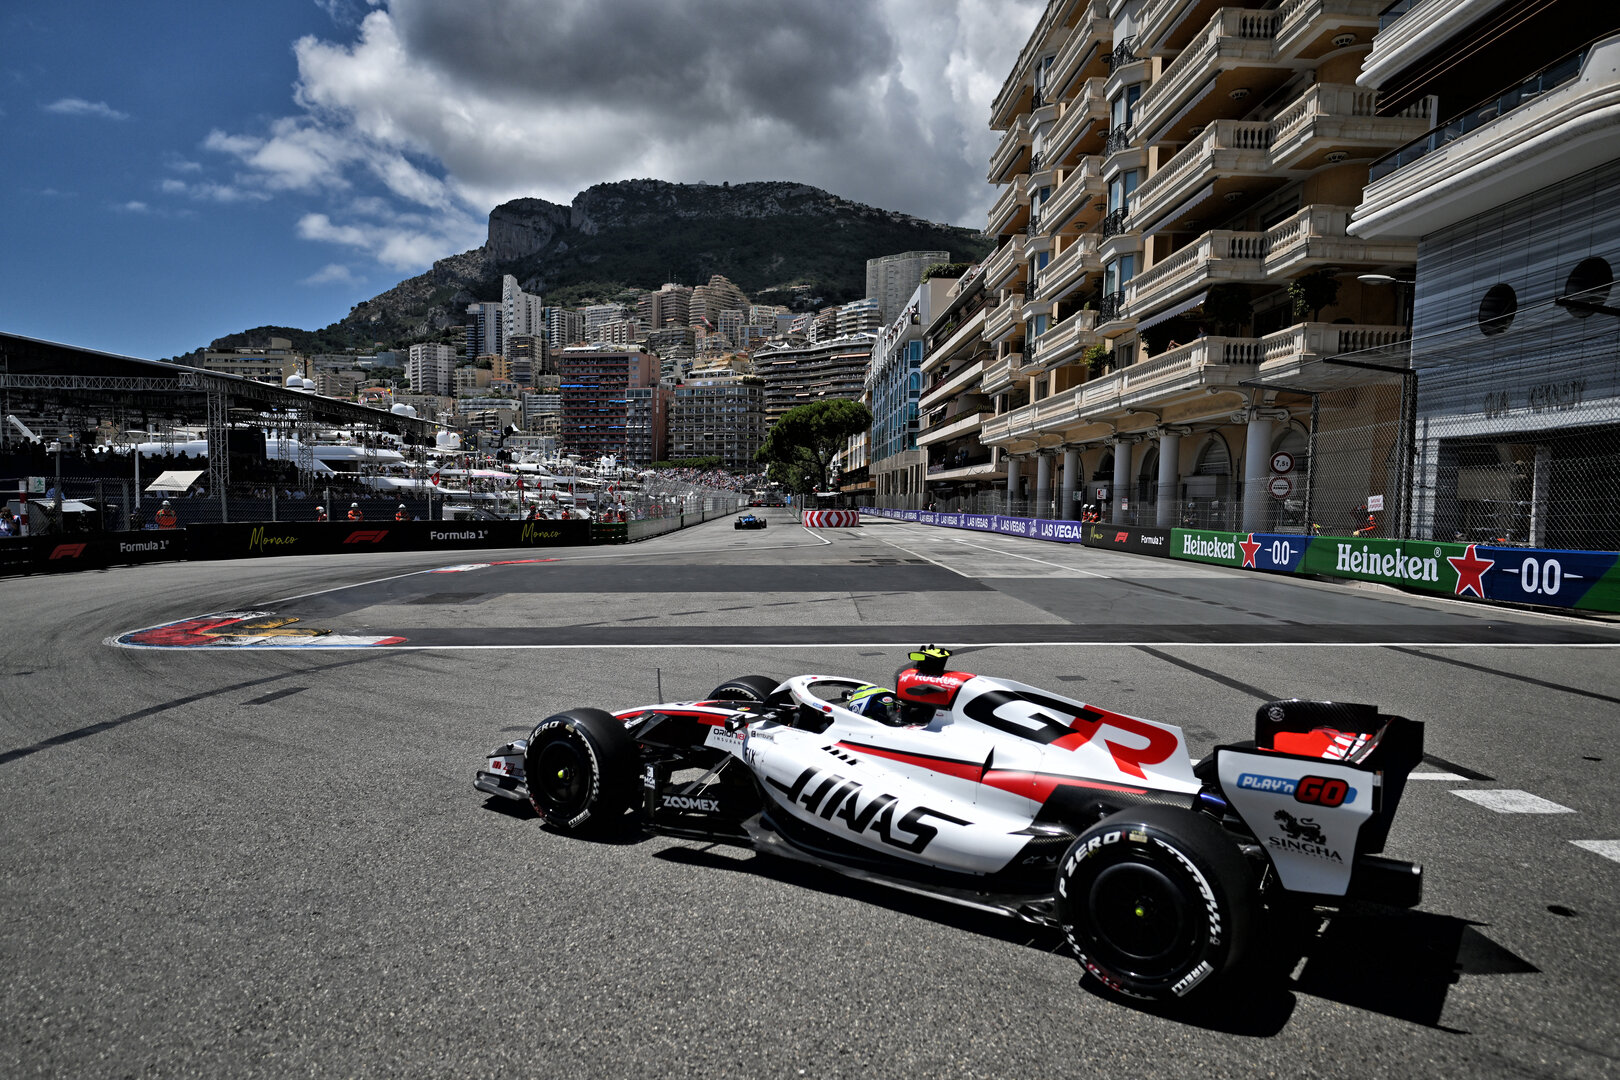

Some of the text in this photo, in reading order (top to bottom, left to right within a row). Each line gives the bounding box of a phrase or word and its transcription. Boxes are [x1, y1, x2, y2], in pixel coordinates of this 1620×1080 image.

[521, 522, 561, 544] Monaco
[967, 517, 988, 528] LAS VEGAS
[1001, 519, 1009, 531] LAS
[1010, 520, 1025, 533] VEGAS
[1042, 524, 1053, 537] LAS
[120, 541, 159, 552] Formula
[249, 526, 298, 552] Monaco
[430, 531, 476, 540] Formula
[1141, 535, 1159, 545] Formula
[1183, 534, 1235, 559] Heineken
[1272, 540, 1290, 565] 0.0
[1336, 543, 1438, 581] Heineken
[1522, 557, 1561, 595] 0.0
[530, 721, 560, 746] ZERO
[713, 728, 745, 740] ORION18
[662, 795, 720, 812] ZOOMEX
[1302, 776, 1347, 806] GO
[765, 766, 975, 854] HAAS
[1269, 836, 1343, 861] SINGHA
[1059, 831, 1121, 898] P ZERO
